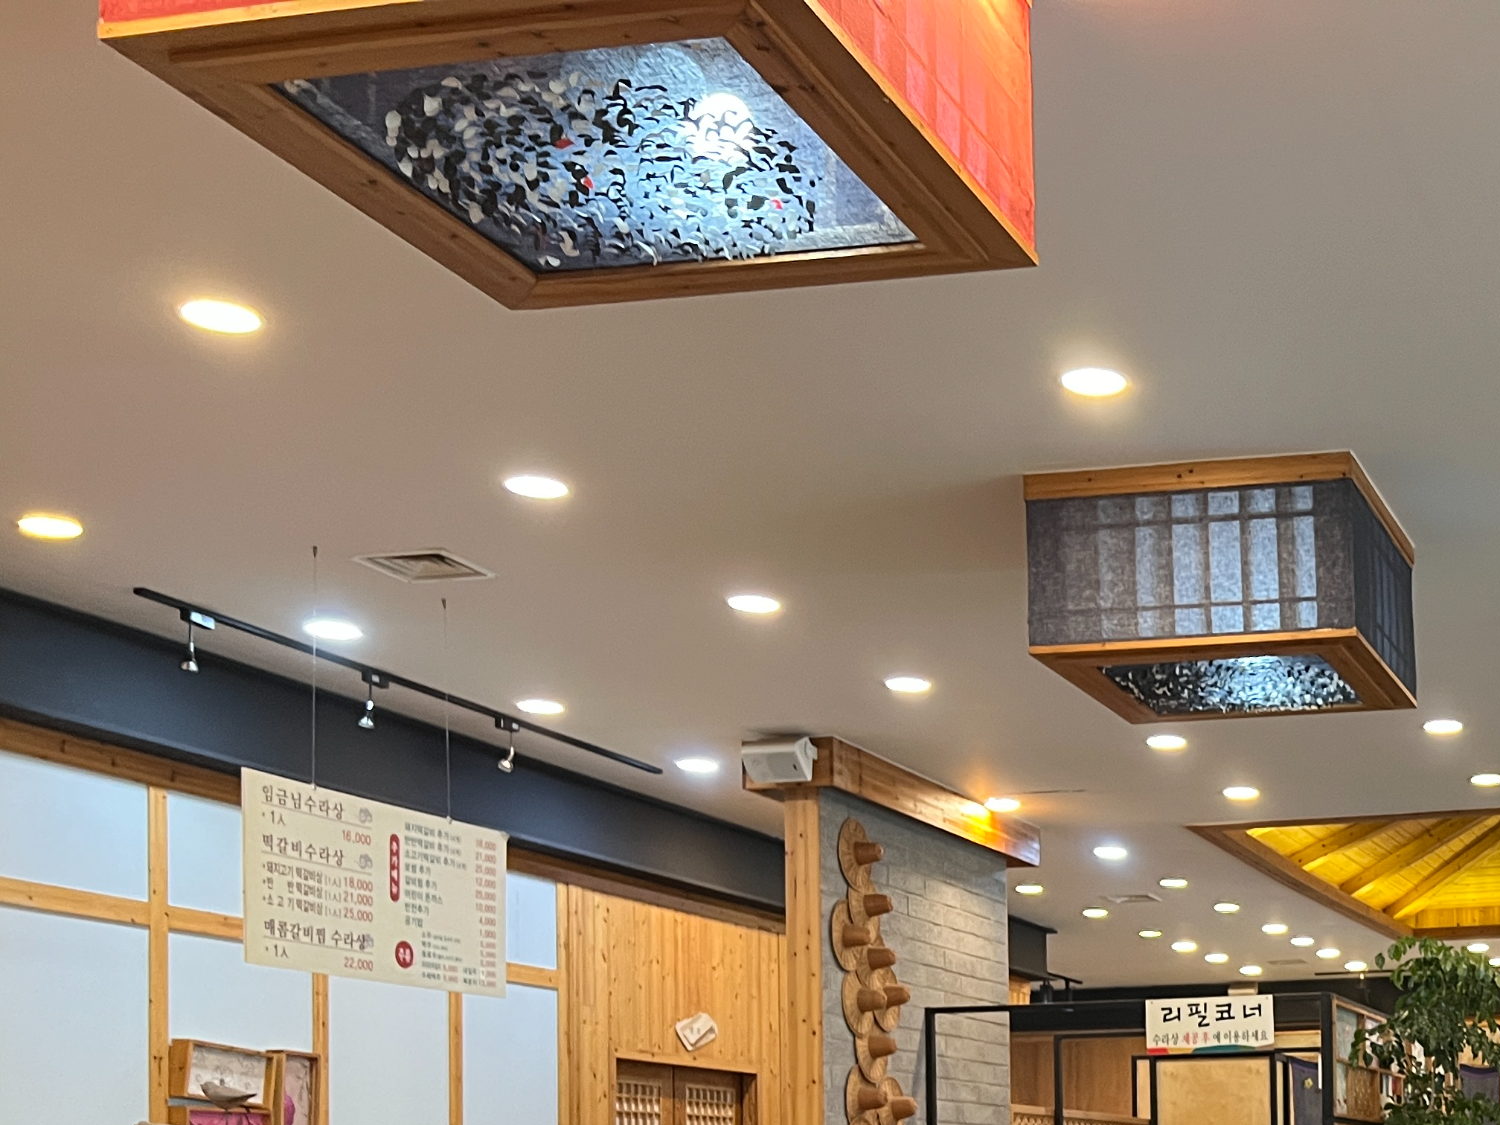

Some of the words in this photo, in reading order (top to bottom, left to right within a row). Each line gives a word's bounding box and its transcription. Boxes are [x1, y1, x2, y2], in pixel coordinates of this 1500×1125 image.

[262, 784, 345, 821] 임금님수라상
[262, 833, 345, 867] 떡갈비수라상
[344, 876, 373, 893] 18,000
[343, 891, 373, 907] 21,000
[343, 907, 373, 923] 25,000
[264, 918, 326, 945] 매콤갈비찜
[331, 929, 366, 951] 수라상
[344, 956, 373, 972] 22,000
[1160, 1002, 1262, 1028] 리필코너
[1152, 1032, 1180, 1047] 수라상
